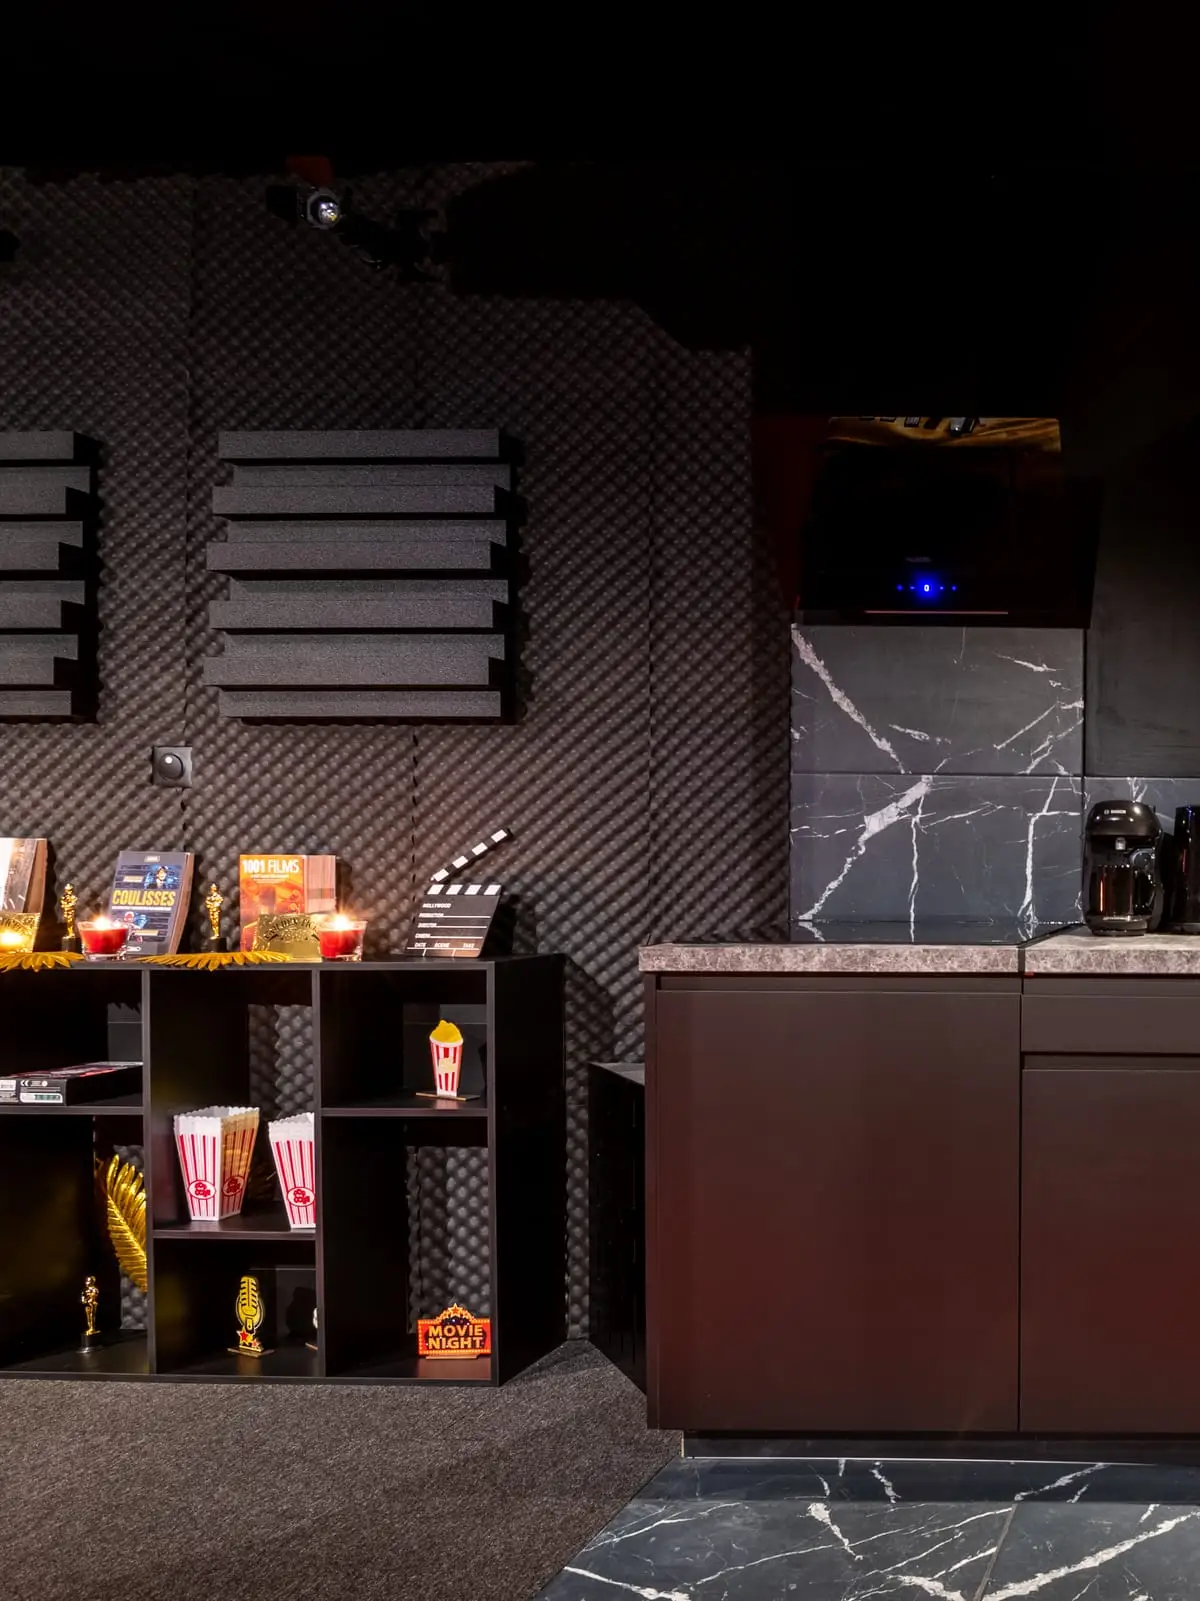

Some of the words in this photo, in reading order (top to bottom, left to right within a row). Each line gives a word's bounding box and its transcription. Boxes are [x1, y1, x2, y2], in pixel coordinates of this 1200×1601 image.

[242, 859, 265, 873] 1001
[268, 859, 299, 873] FILMS
[112, 889, 176, 906] COULISSES
[428, 1325, 483, 1337] MOVIE
[428, 1337, 483, 1349] NIGHT
